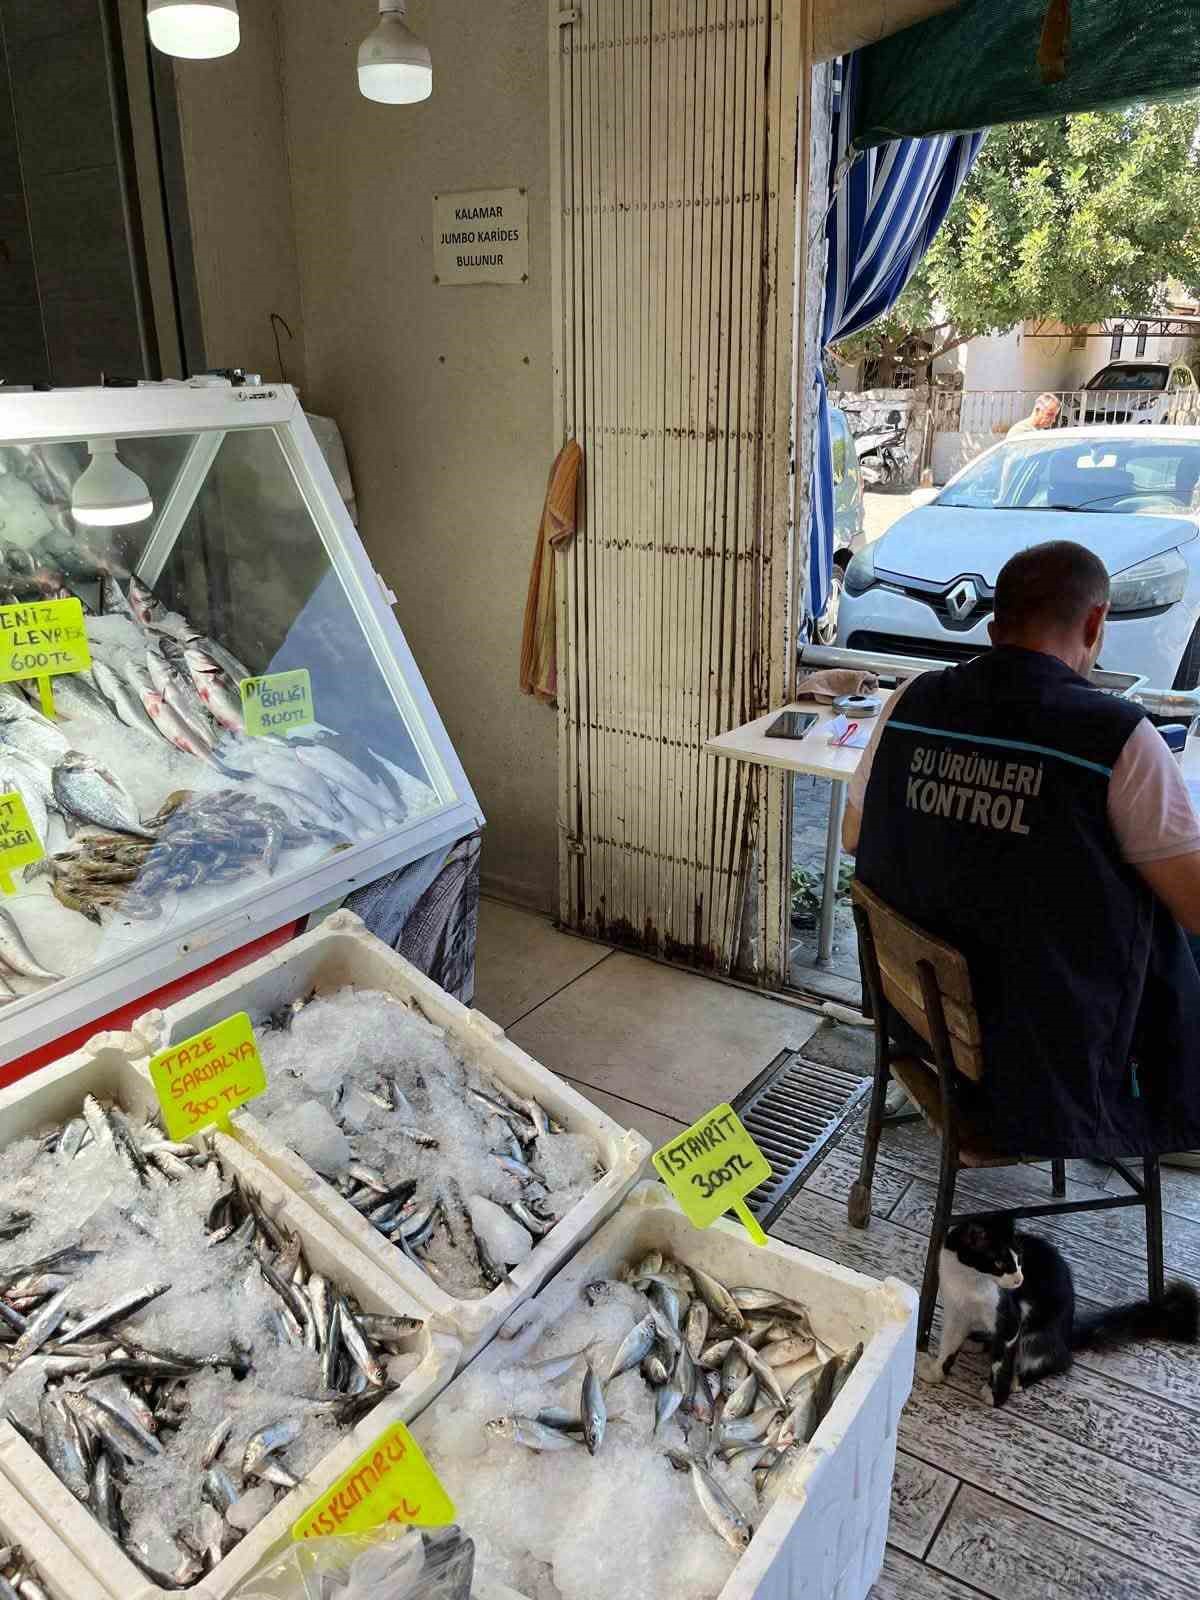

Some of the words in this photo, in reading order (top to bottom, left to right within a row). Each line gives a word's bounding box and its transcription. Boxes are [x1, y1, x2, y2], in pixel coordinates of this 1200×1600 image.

[455, 206, 503, 220] KALAMAR
[440, 231, 475, 245] JUMBO
[477, 227, 519, 243] KARİDES
[456, 254, 504, 267] BULUNUR
[0, 607, 59, 630] ENİZ
[11, 652, 72, 672] 600TL
[246, 679, 272, 698] DİL
[910, 747, 936, 775] SU
[938, 747, 1043, 796] ÜRÜNLERİ
[906, 776, 1030, 835] KONTROL
[160, 1036, 216, 1075] TAZE
[171, 1041, 256, 1099] SARDALYA
[659, 1112, 735, 1177] İSTAVRİT
